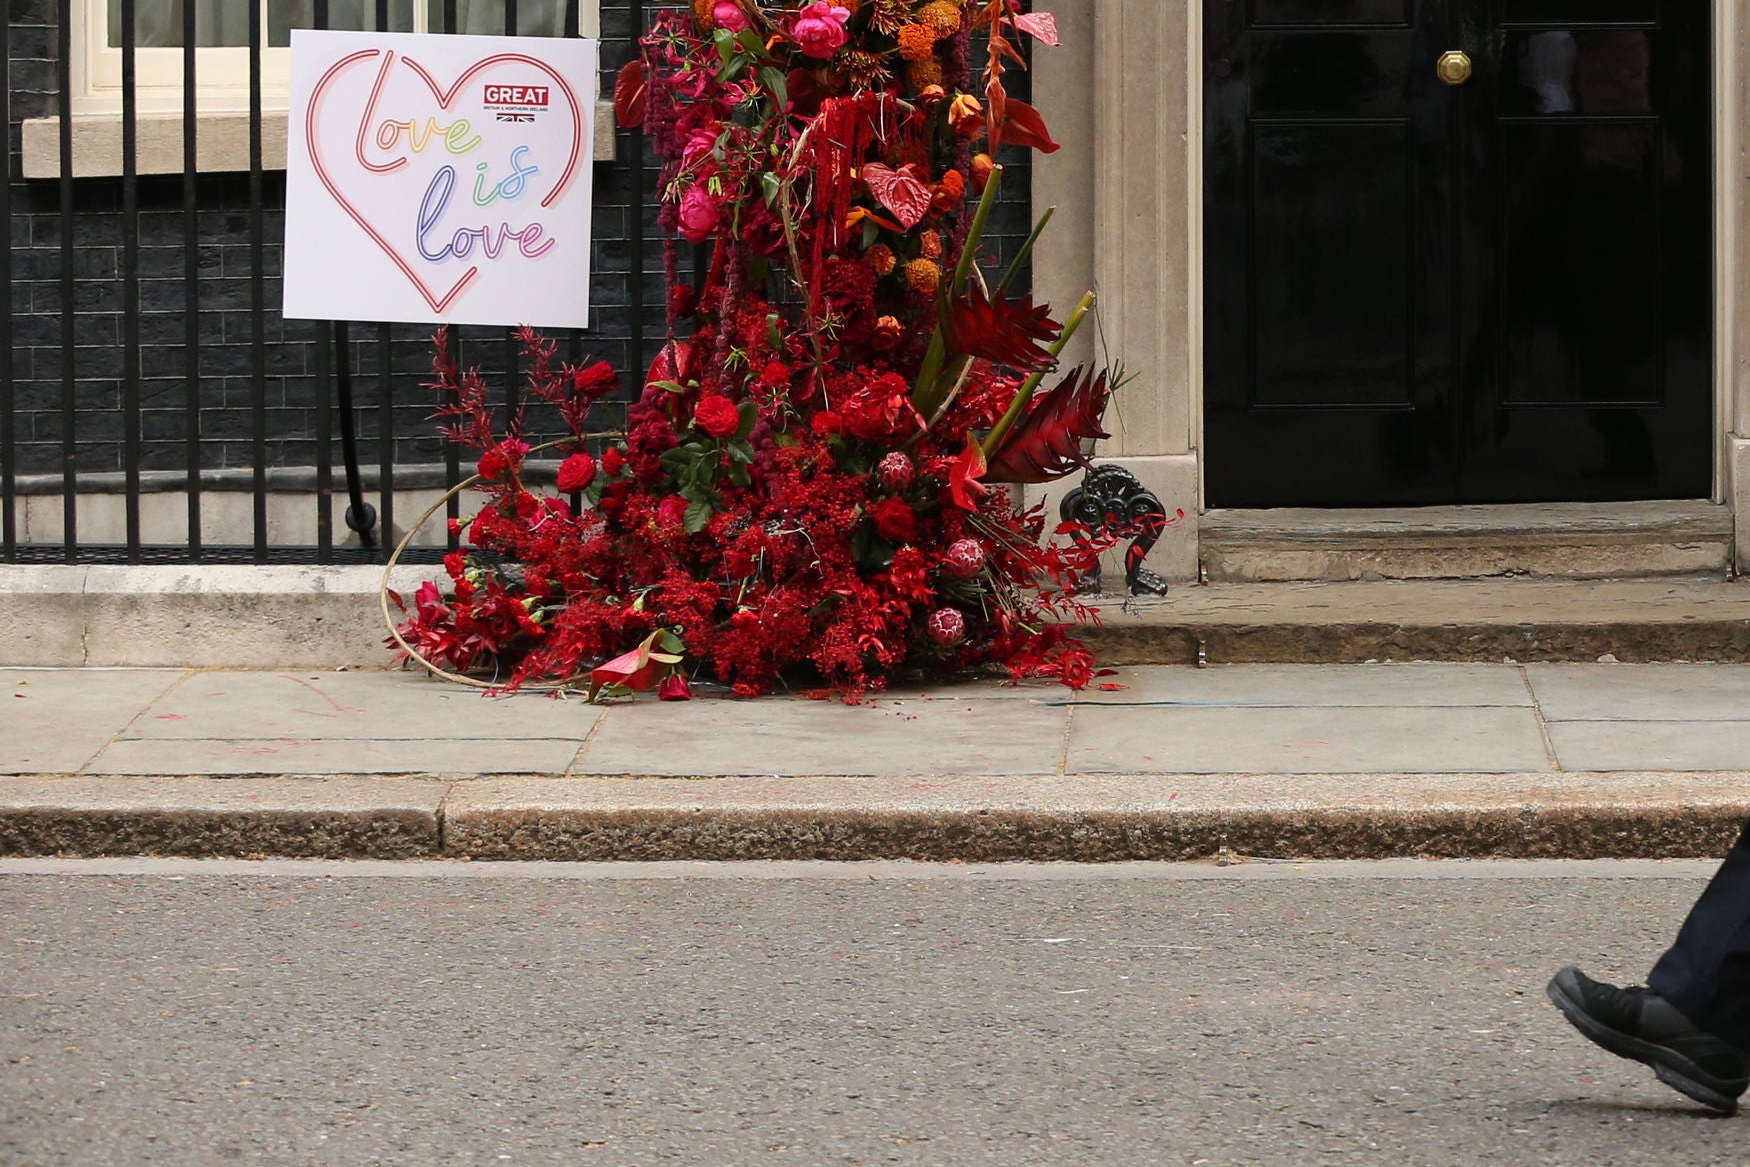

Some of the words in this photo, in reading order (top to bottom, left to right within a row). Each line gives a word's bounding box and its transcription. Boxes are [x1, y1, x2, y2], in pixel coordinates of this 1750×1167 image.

[355, 49, 483, 172] Love
[486, 86, 547, 104] GREAT
[416, 164, 556, 262] love
[472, 145, 538, 206] is
